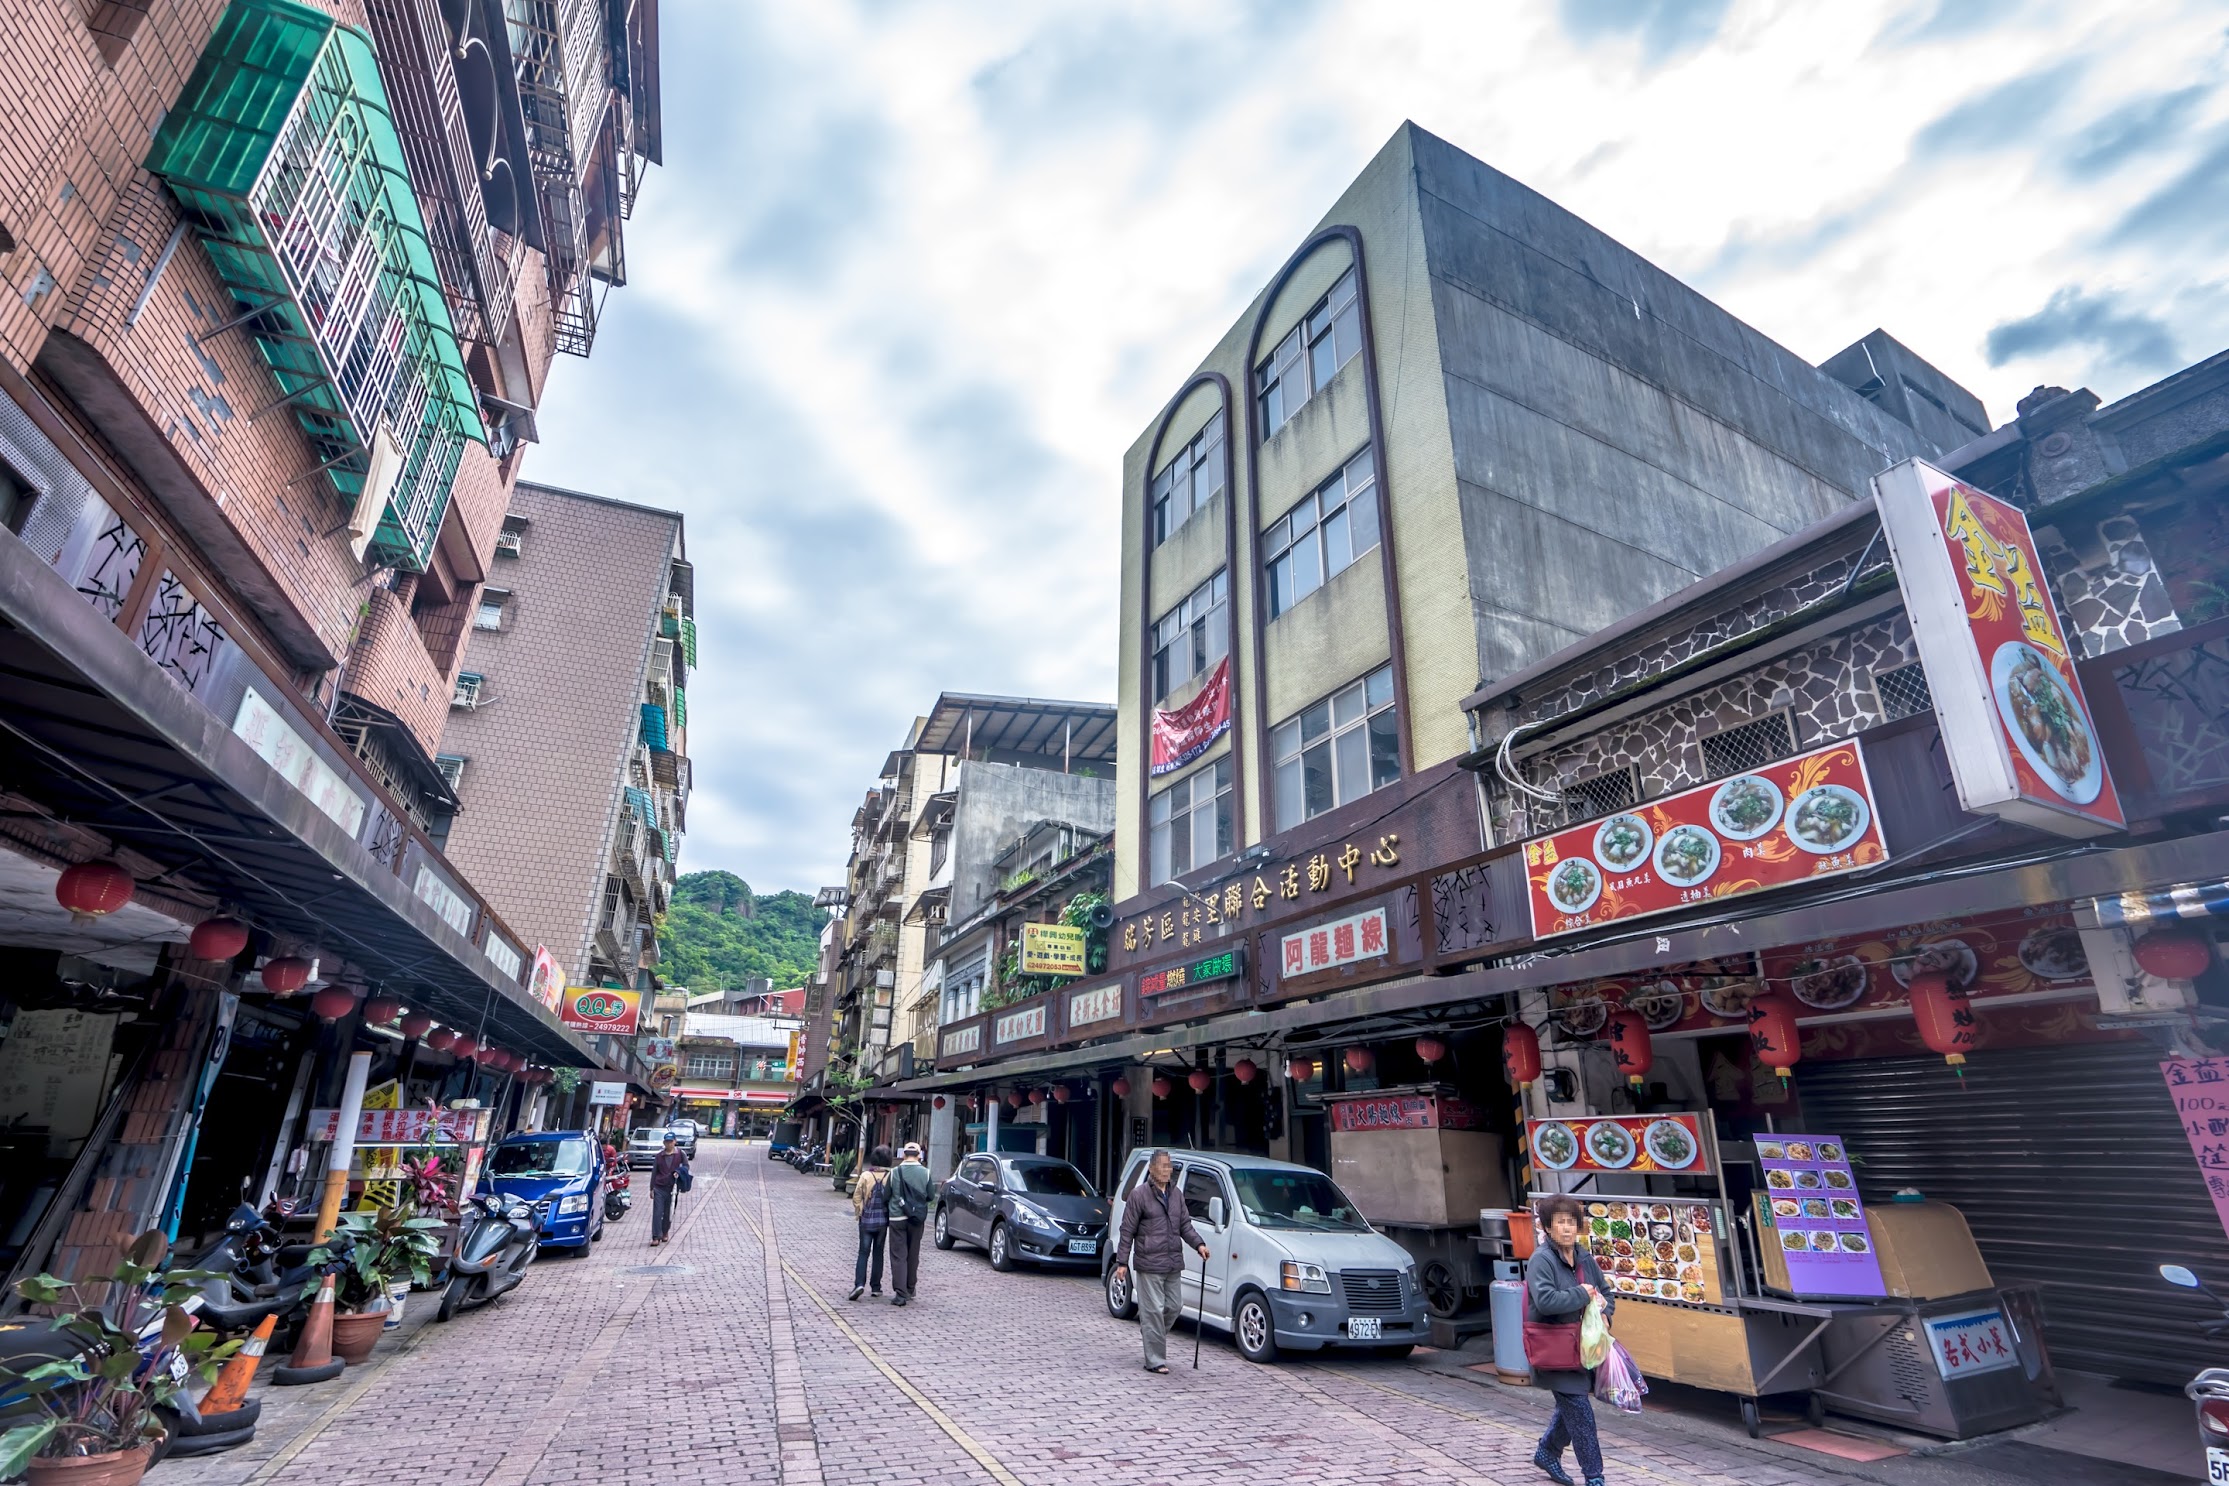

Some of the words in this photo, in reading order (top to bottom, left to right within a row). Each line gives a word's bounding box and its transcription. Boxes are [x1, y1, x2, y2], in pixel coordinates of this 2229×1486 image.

[1124, 911, 1175, 951] 瑞芳區
[1285, 915, 1384, 972] 阿龍麵線
[2166, 1059, 2229, 1086] 金益
[1356, 1101, 1402, 1126] 大腸麵線
